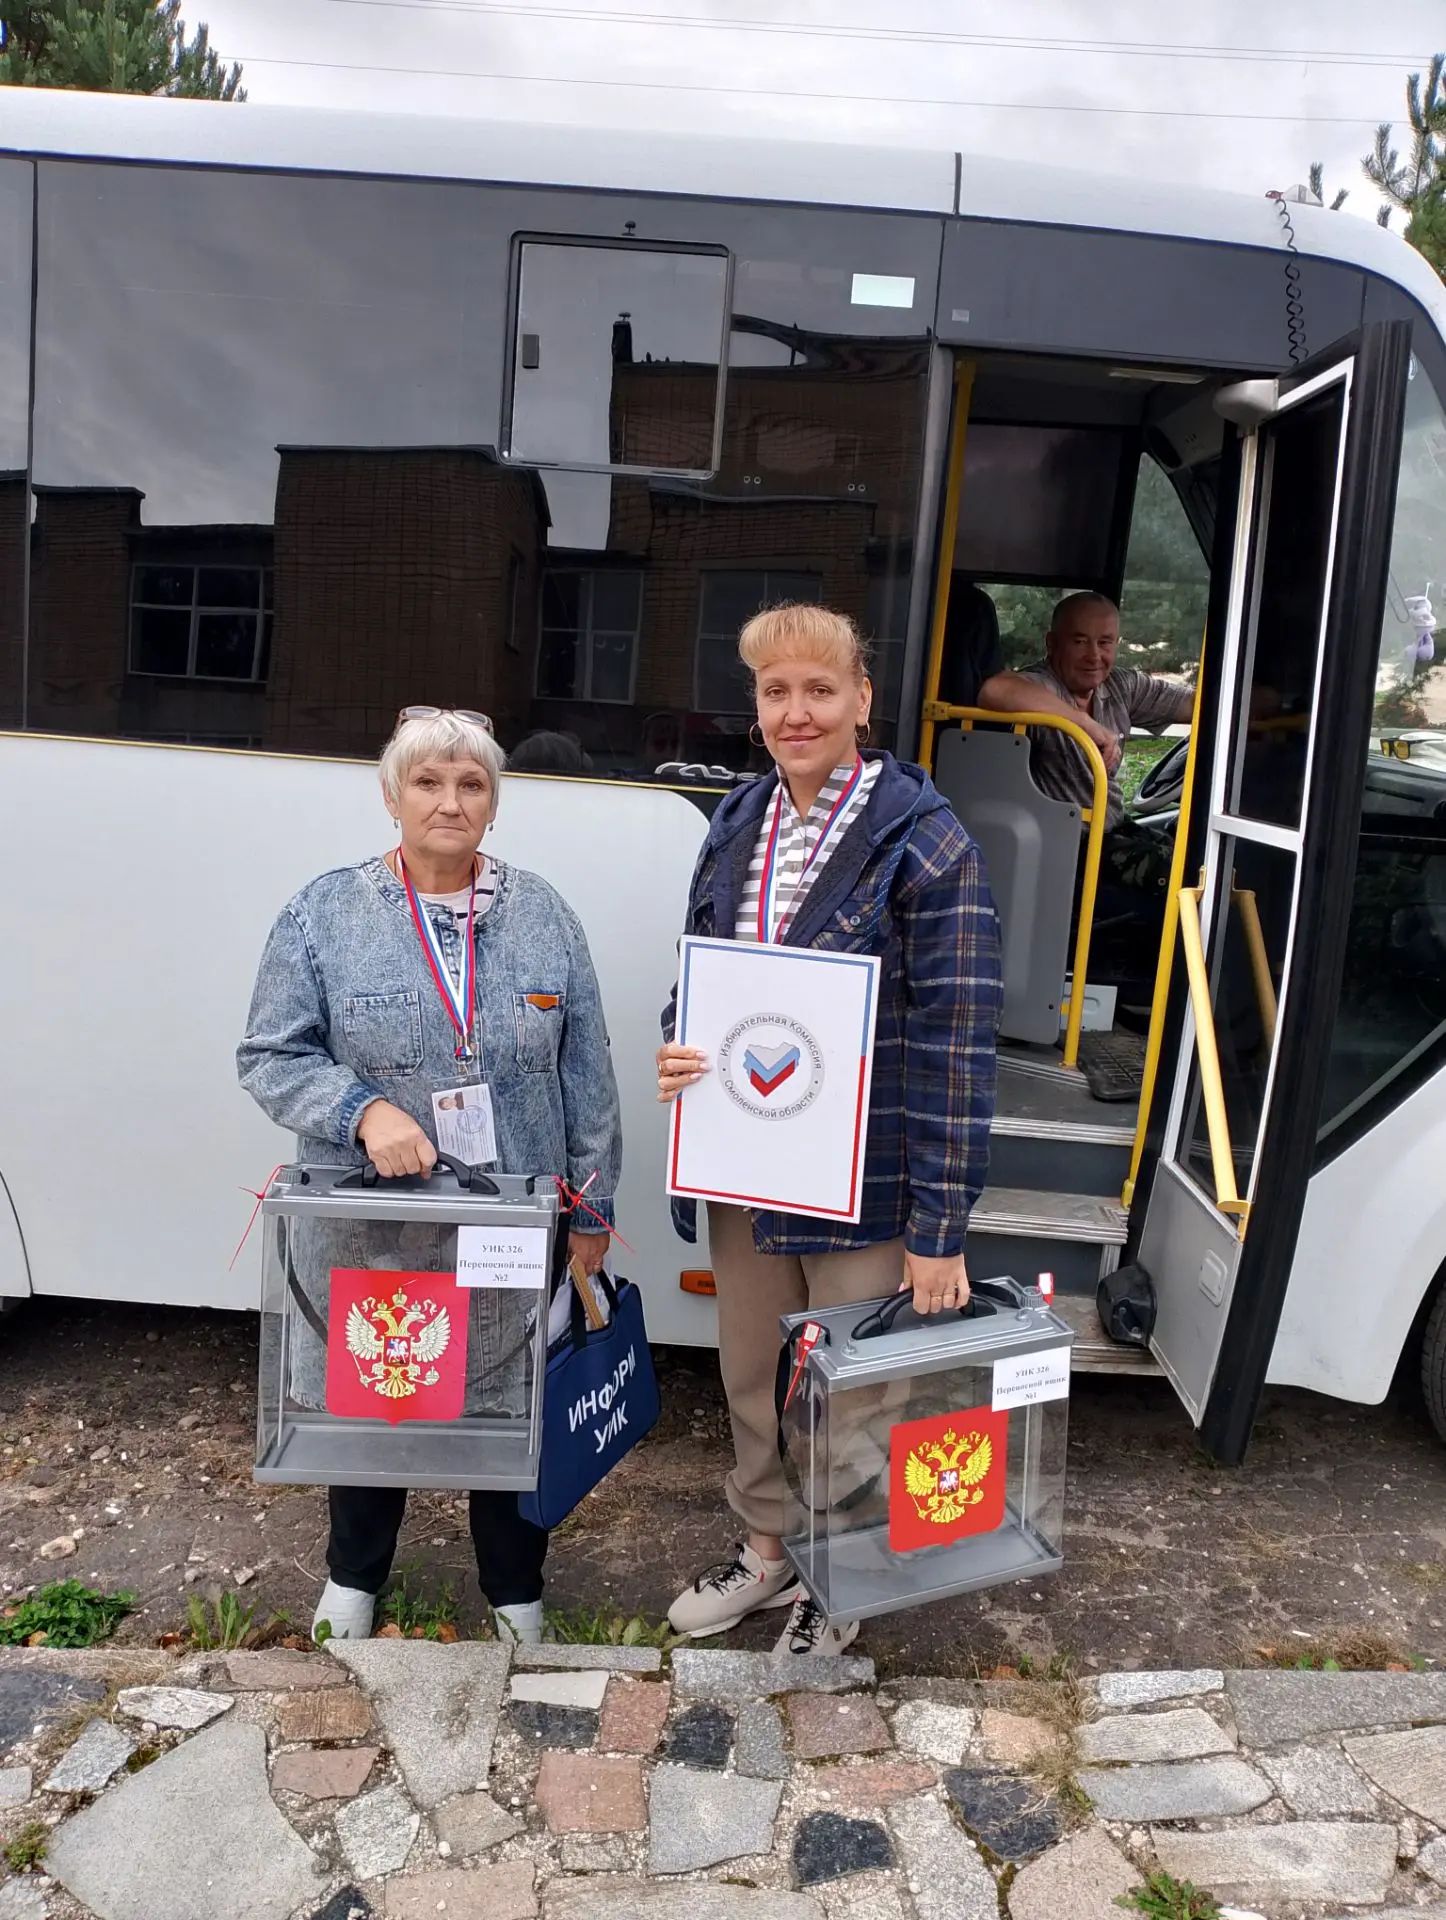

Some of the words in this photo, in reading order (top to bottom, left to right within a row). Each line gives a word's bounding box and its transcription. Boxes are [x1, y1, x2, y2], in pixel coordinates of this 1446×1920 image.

[719, 1015, 788, 1057] Избирательная
[789, 1021, 822, 1069] Комиссия
[724, 1079, 777, 1118] Смоленской
[778, 1091, 815, 1117] области
[481, 1244, 505, 1254] УИК
[506, 1245, 523, 1254] 326
[459, 1260, 514, 1270] Переносной
[517, 1263, 544, 1271] ящик
[492, 1273, 509, 1282] №2
[1036, 1366, 1050, 1374] 326
[567, 1343, 637, 1433] ИНФОРМ
[996, 1380, 1043, 1395] Переносной
[1025, 1392, 1037, 1400] №1
[593, 1399, 629, 1454] УИК
